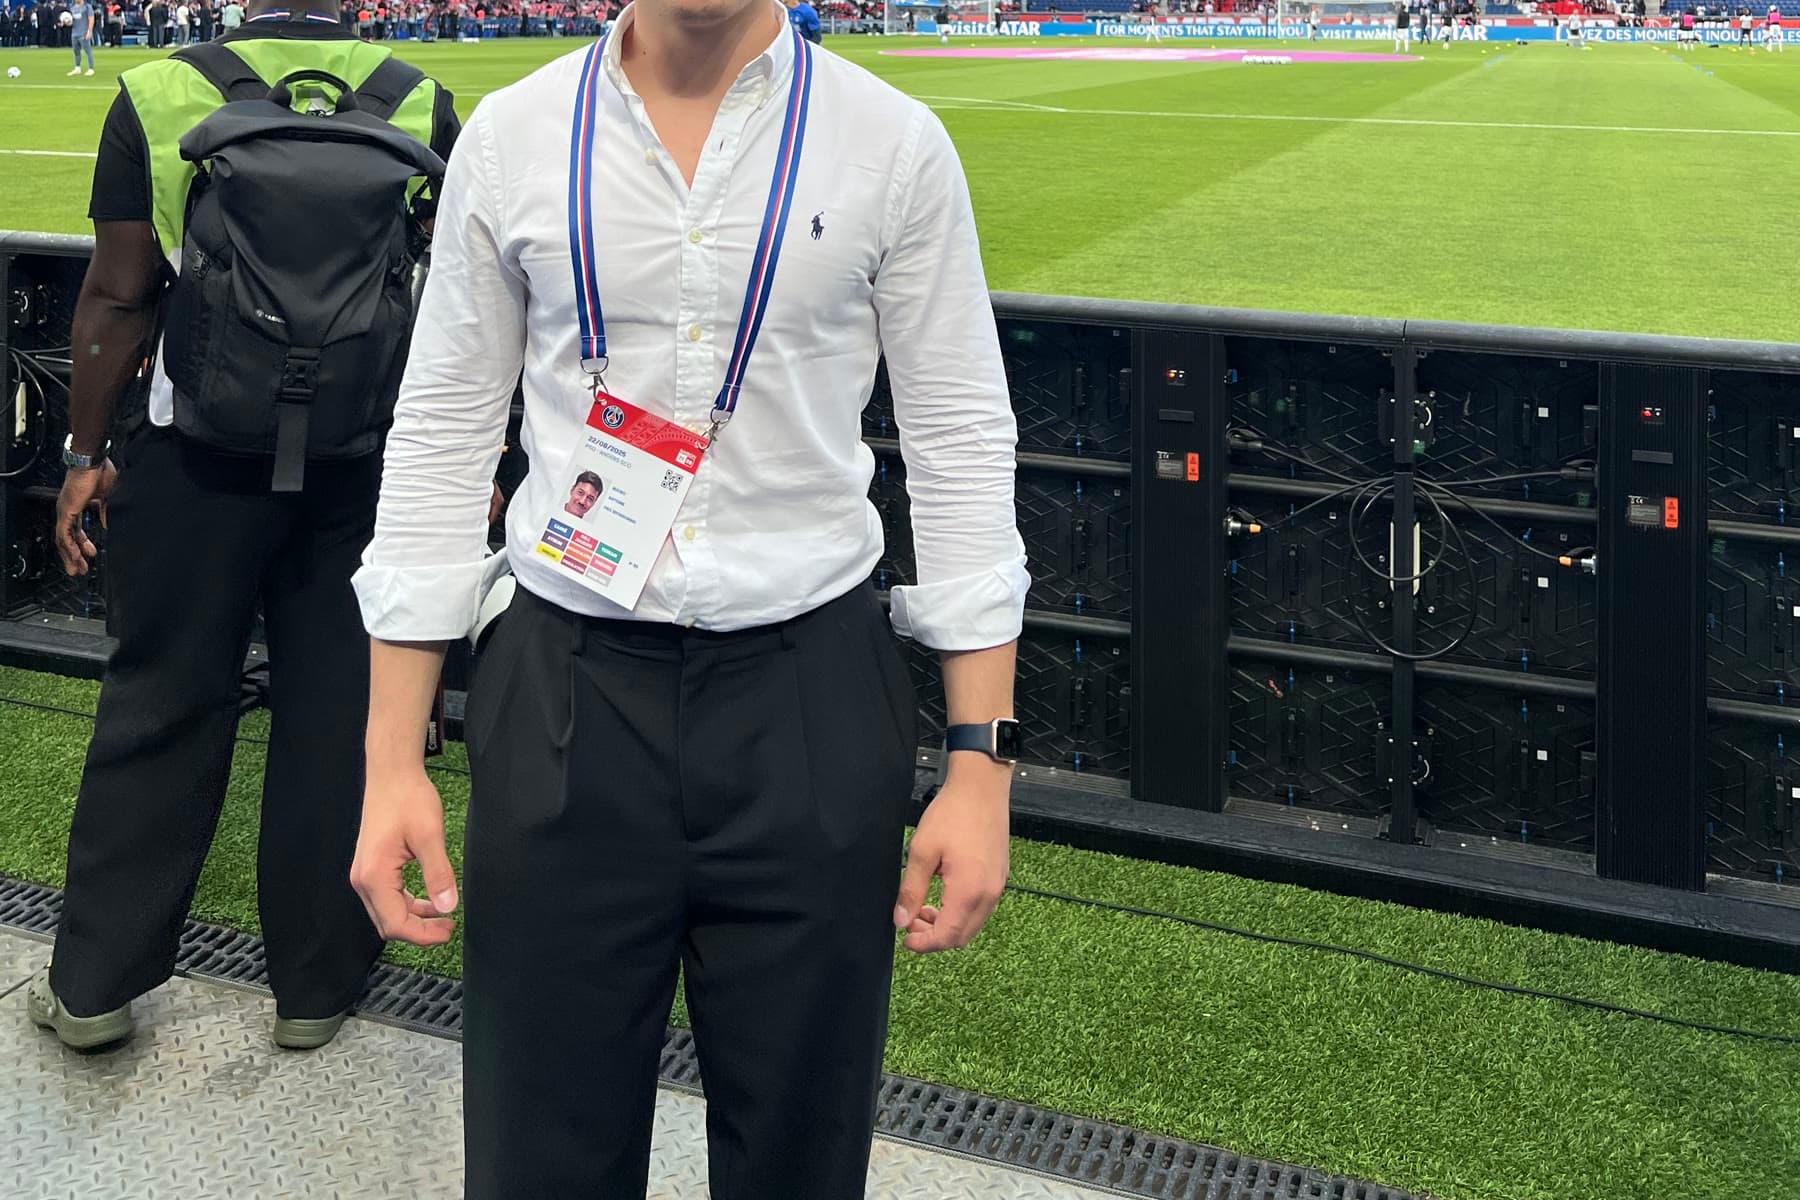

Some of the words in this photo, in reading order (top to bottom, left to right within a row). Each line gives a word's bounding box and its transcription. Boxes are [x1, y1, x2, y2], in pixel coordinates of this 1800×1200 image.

[1103, 25, 1126, 35] FOR
[1185, 26, 1216, 36] THAT
[1217, 26, 1244, 37] STAY
[1279, 27, 1303, 37] YOU
[1321, 29, 1351, 40] VISIT
[1606, 30, 1632, 41] DES
